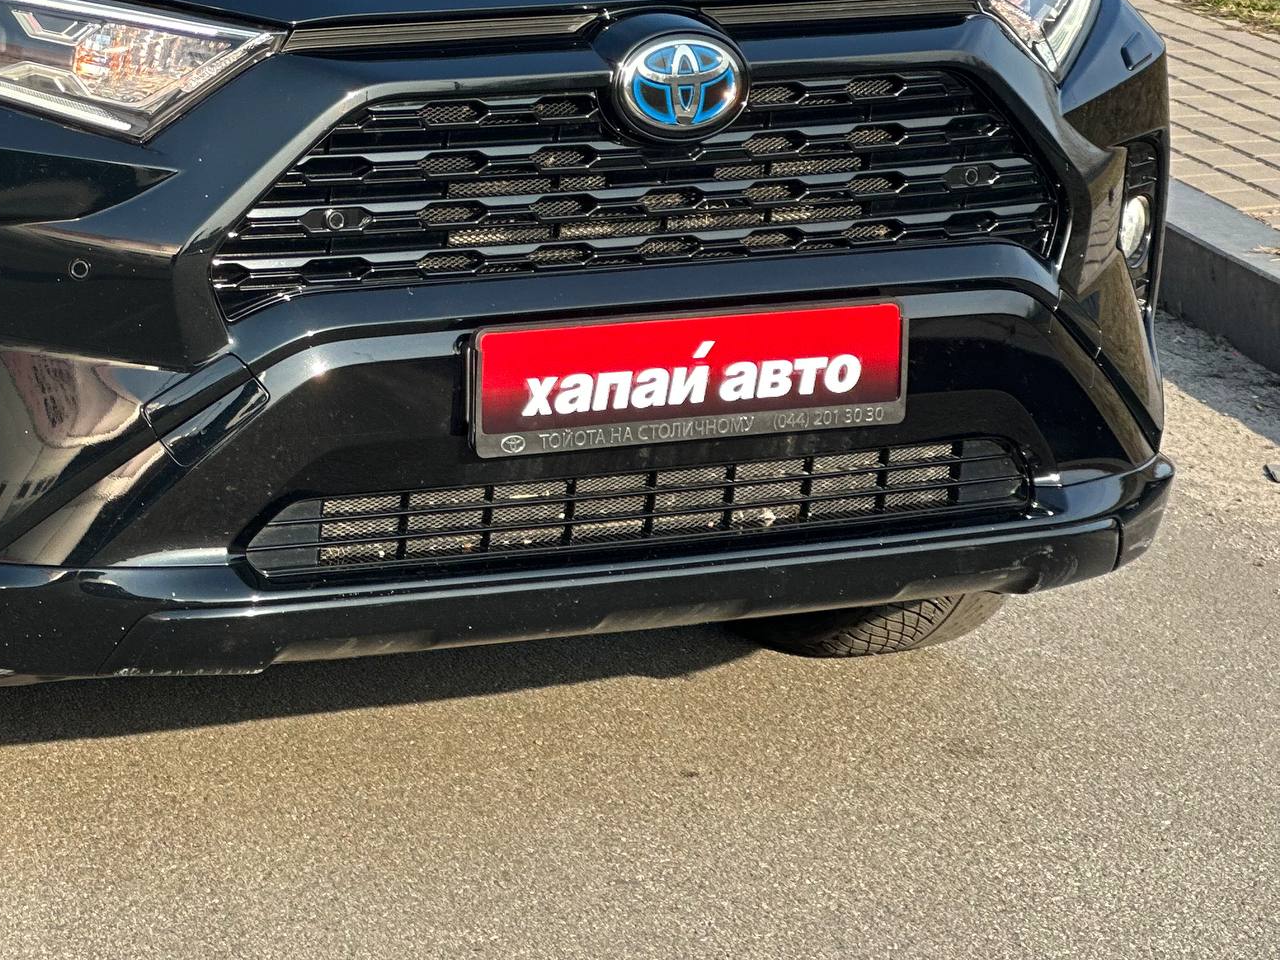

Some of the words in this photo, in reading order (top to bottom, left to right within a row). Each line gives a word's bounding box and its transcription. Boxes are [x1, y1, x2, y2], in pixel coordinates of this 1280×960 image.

[719, 354, 862, 402] авто
[538, 427, 607, 450] ТОЙОТА
[610, 424, 634, 444] НА
[637, 415, 756, 441] СТОЛИЧНОМУ
[772, 411, 810, 431] (044)
[813, 409, 839, 427] 201
[844, 407, 863, 424] 30
[865, 406, 885, 422] 30
